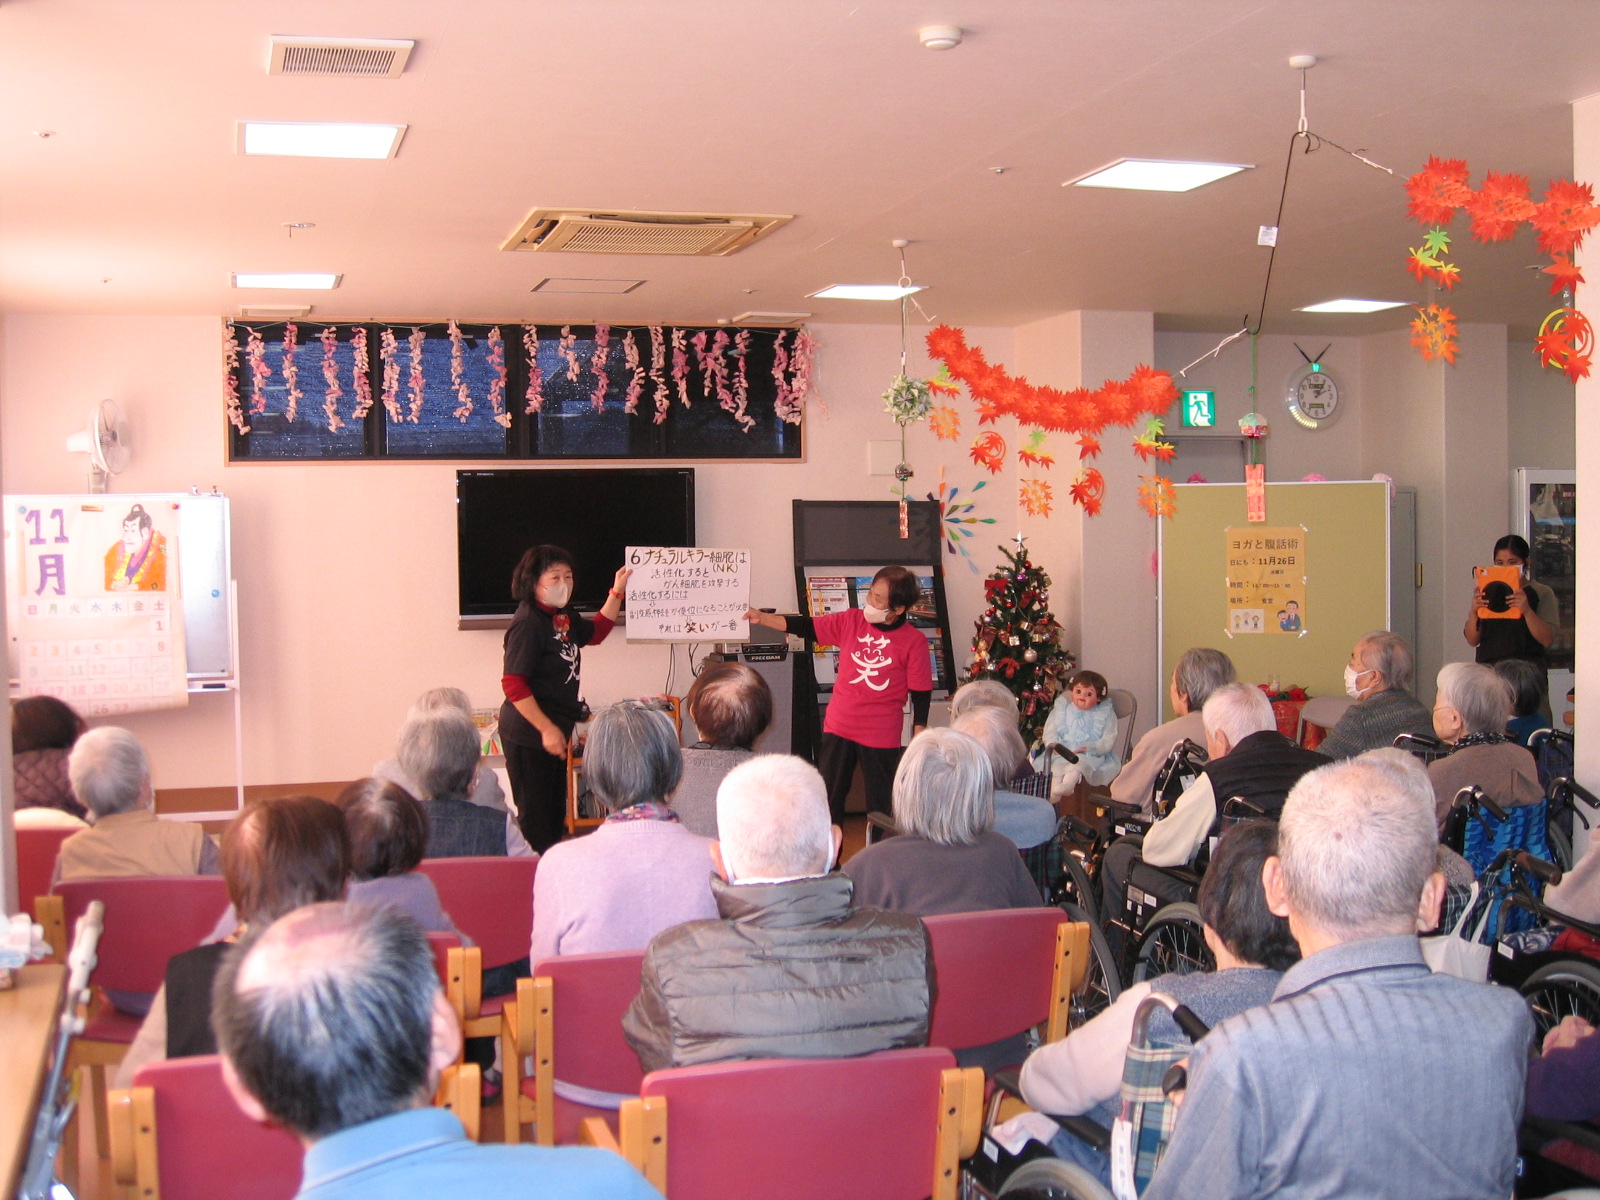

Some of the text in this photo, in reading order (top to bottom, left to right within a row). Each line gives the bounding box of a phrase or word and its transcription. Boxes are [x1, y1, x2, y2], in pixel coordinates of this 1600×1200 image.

[25, 508, 69, 545] 11
[1232, 538, 1298, 550] ヨガと腹話術
[650, 567, 710, 579] 活性化すると
[712, 563, 738, 573] (NK)
[35, 554, 67, 596] 月
[628, 590, 688, 601] 活性化するには
[28, 604, 38, 615] 日
[154, 599, 165, 611] 土
[156, 620, 164, 631] 1
